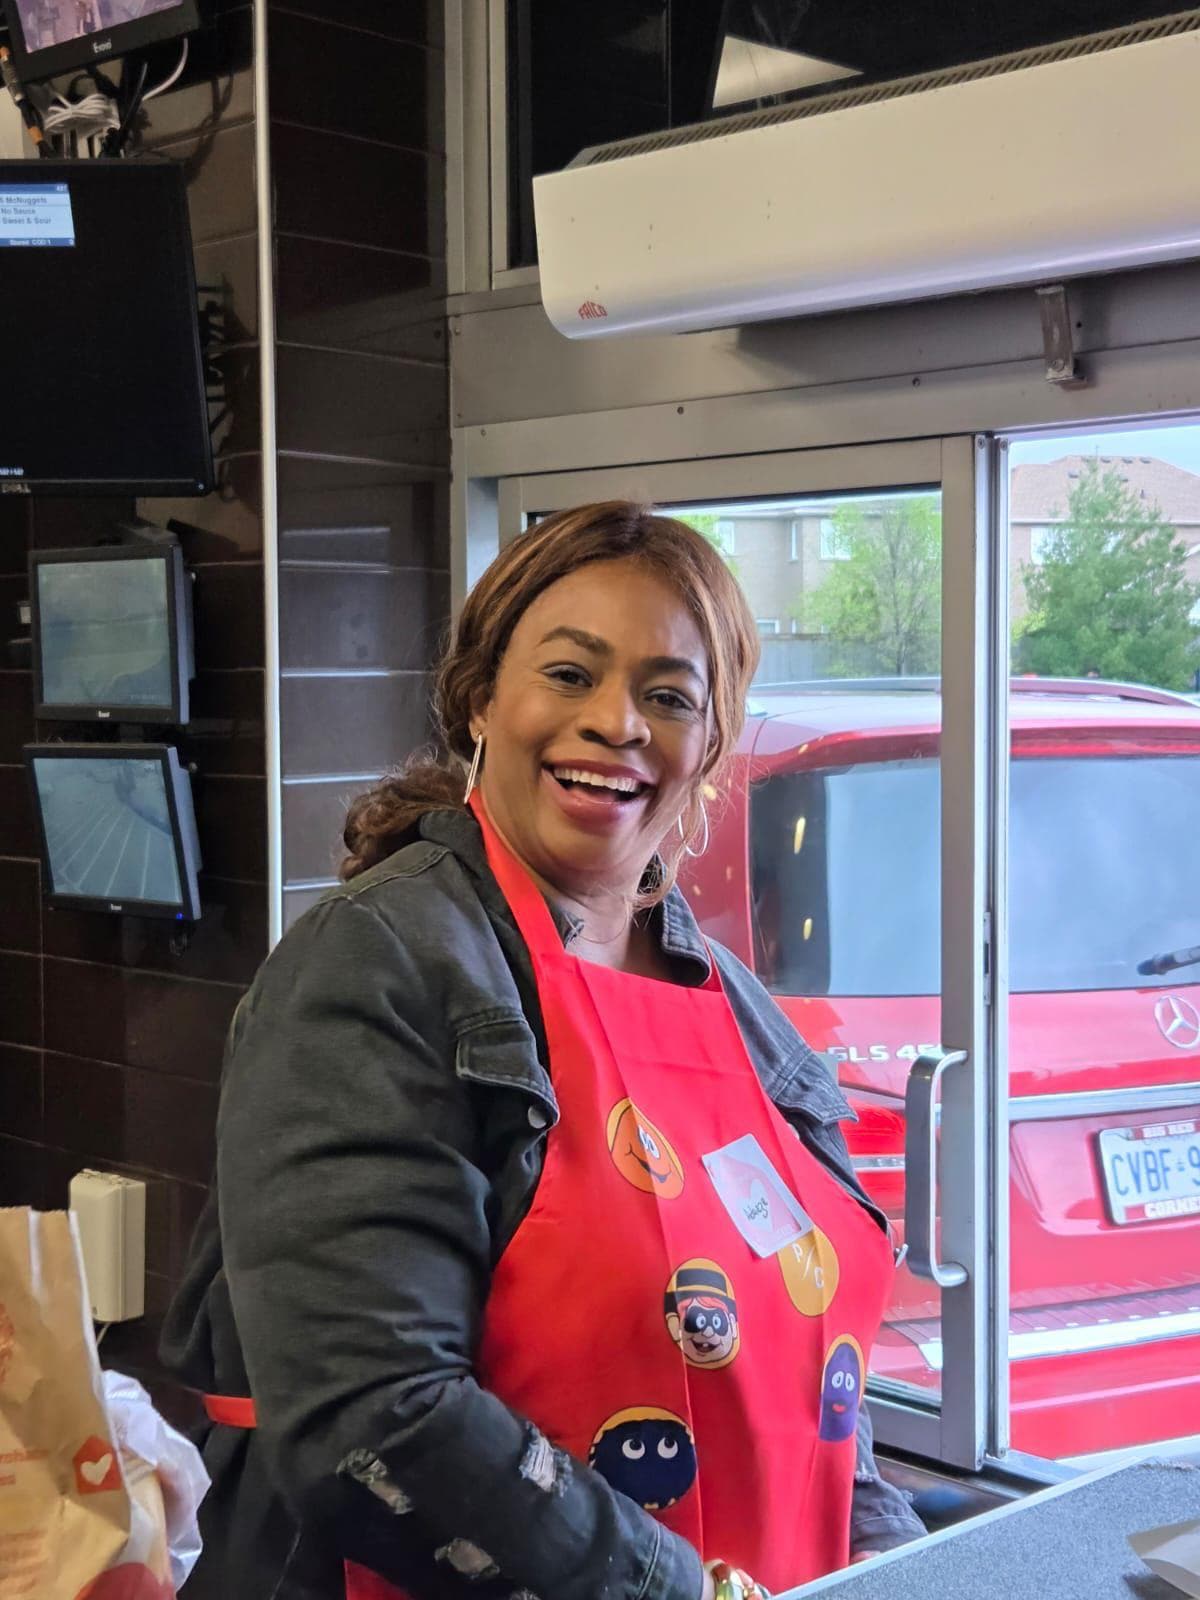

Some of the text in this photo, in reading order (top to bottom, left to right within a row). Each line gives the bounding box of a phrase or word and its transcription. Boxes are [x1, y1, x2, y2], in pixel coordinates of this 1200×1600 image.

[6, 197, 48, 205] McNuggets
[578, 301, 608, 320] FRICO
[827, 1045, 890, 1063] GLS
